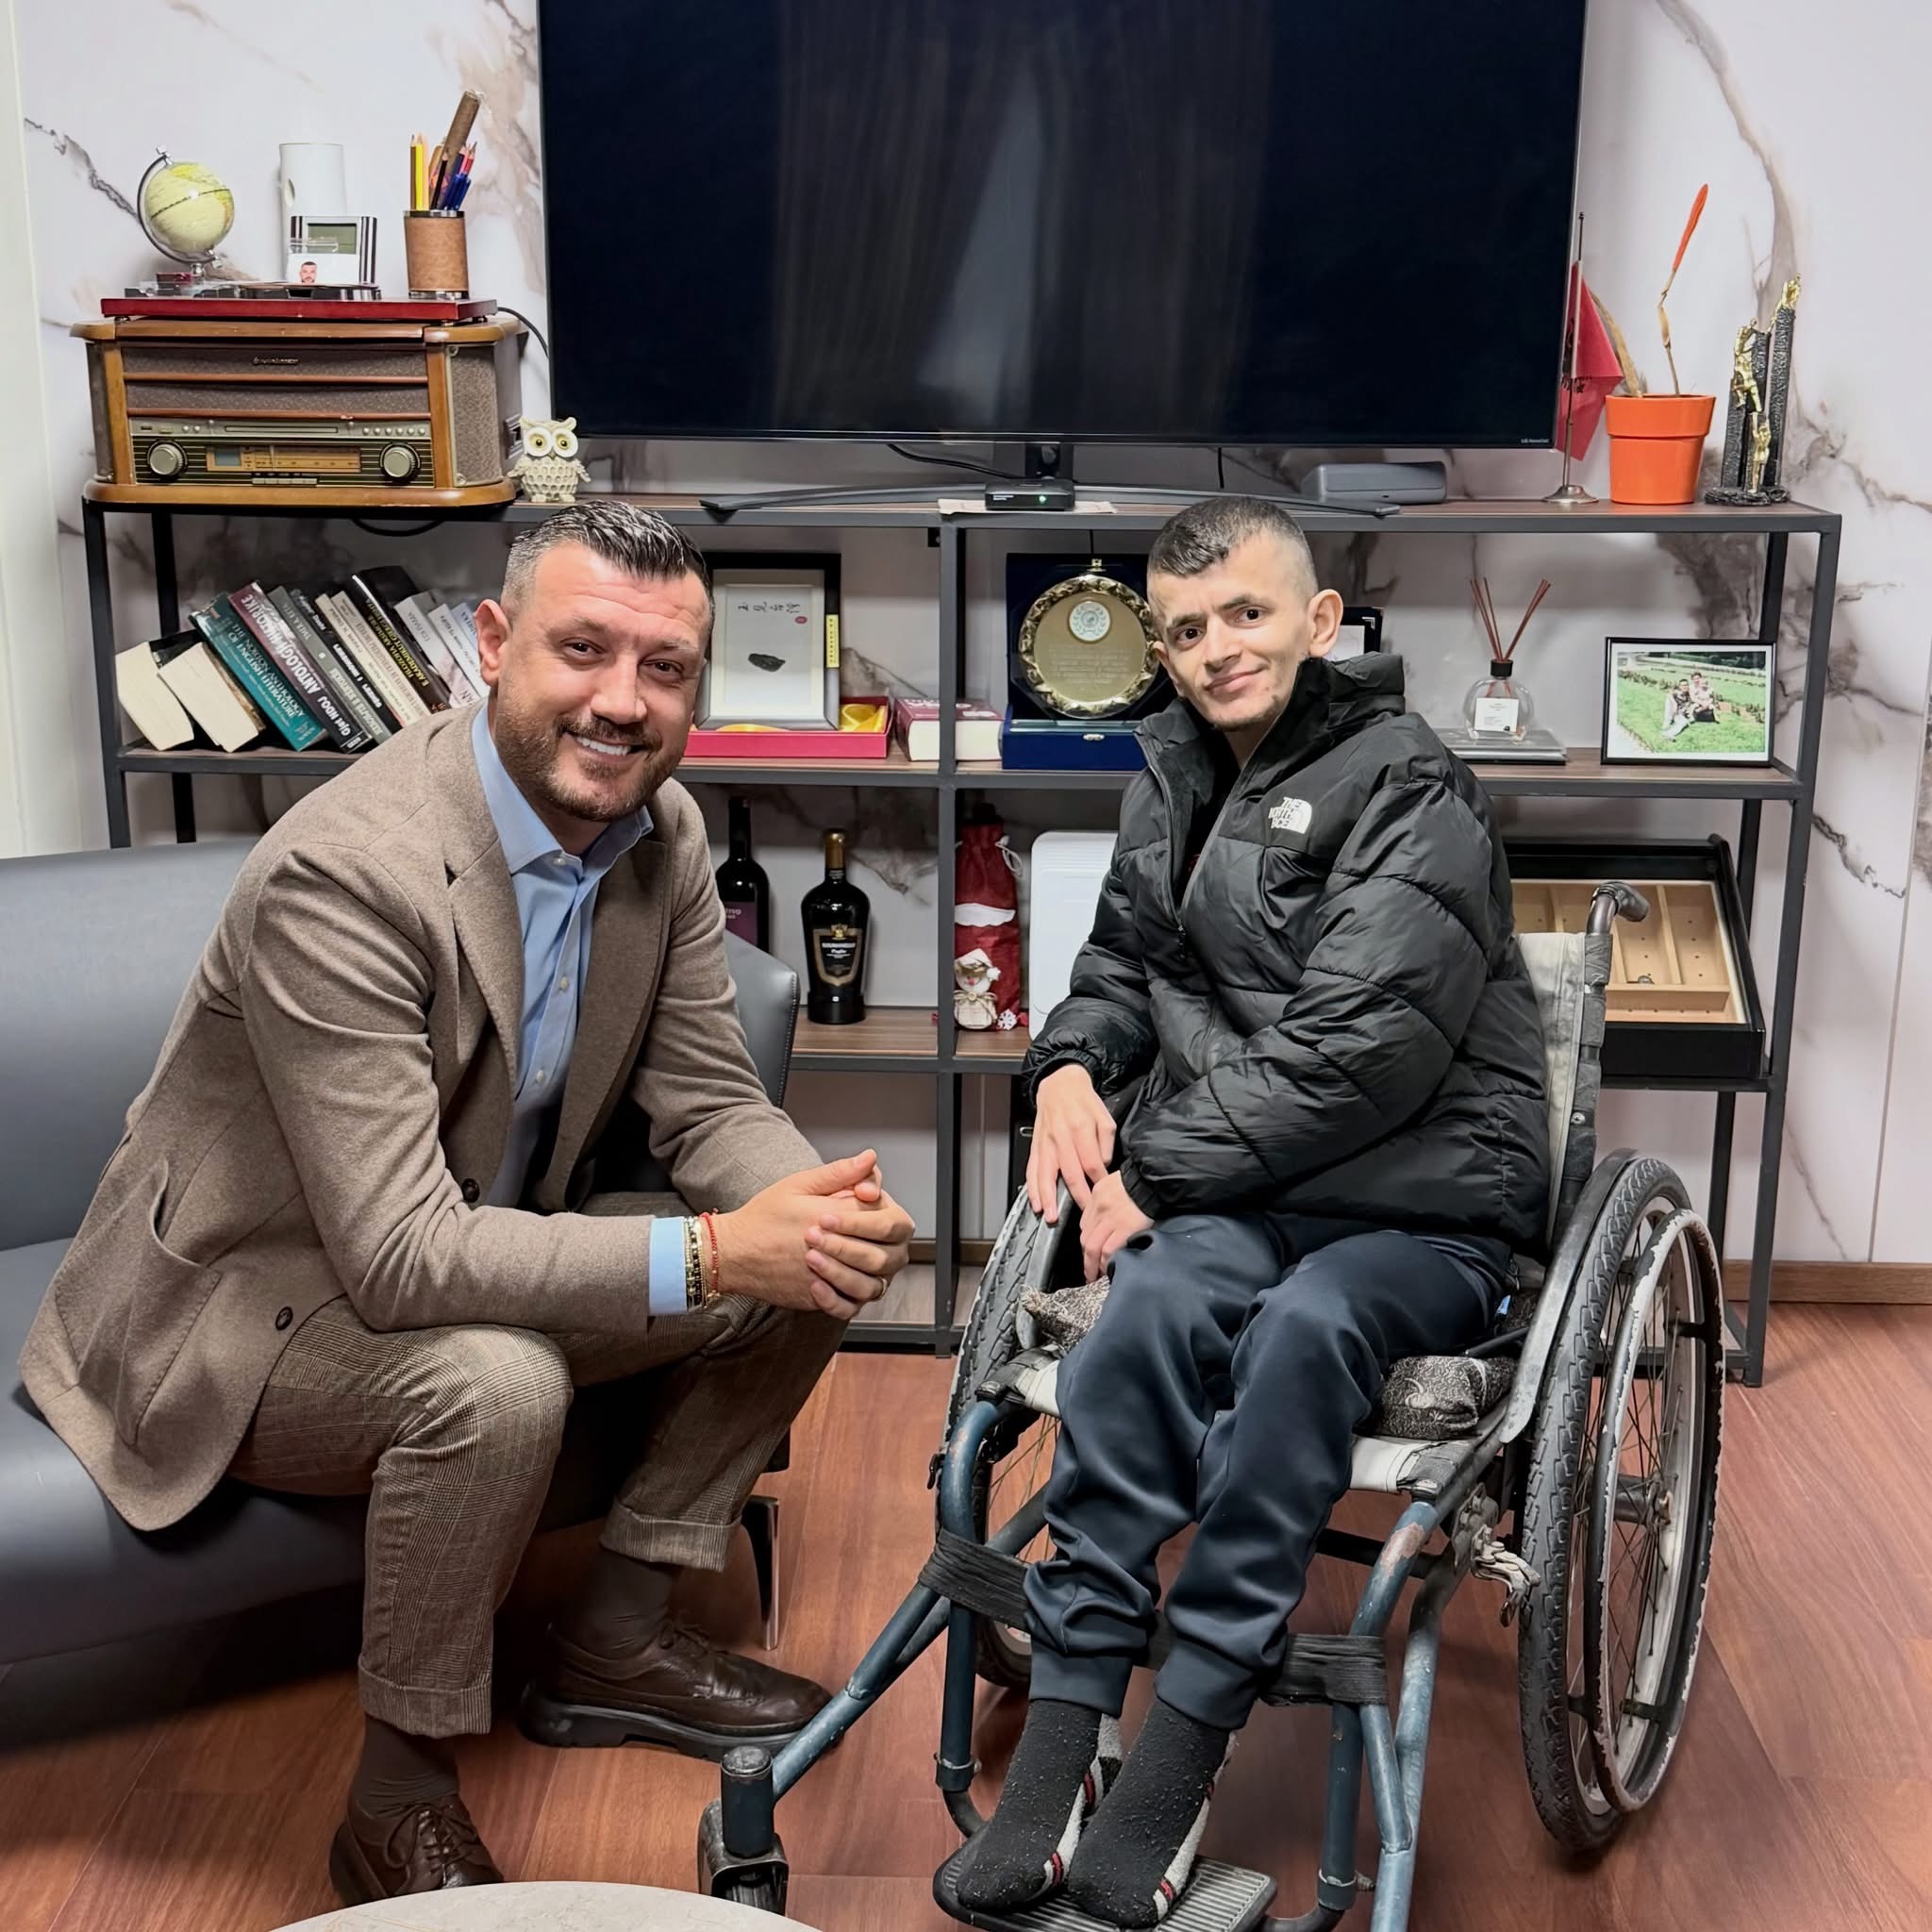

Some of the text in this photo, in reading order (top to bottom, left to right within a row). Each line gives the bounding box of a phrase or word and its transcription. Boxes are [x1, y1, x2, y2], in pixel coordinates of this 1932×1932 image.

[235, 641, 264, 677] ENGLISH
[275, 638, 323, 697] ANTOLOGJI
[387, 643, 415, 678] FILOZOFIA
[315, 693, 341, 722] NDOJ
